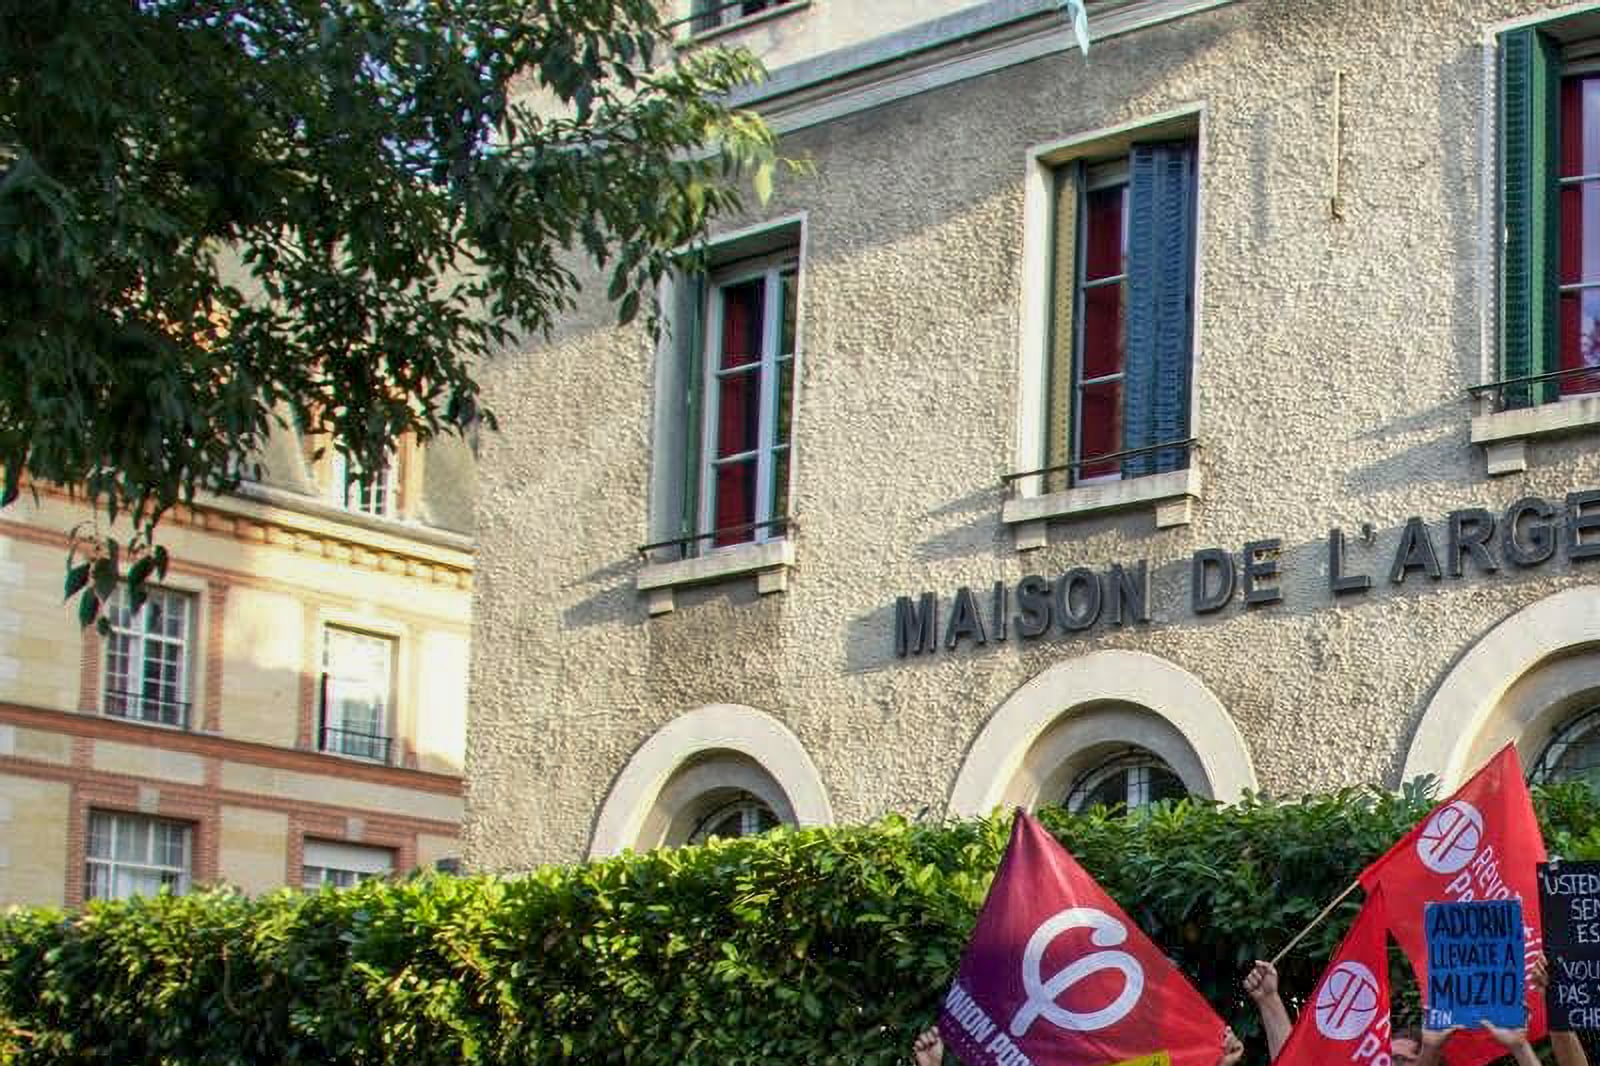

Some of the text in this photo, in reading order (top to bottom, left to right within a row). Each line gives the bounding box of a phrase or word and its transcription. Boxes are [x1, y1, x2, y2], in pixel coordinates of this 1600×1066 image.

[896, 561, 1147, 657] MAISON
[1193, 540, 1281, 613] DE
[1578, 924, 1600, 943] ES
[1504, 943, 1516, 969] A
[1431, 972, 1517, 1008] MUZIO
[1557, 984, 1590, 1004] PAS
